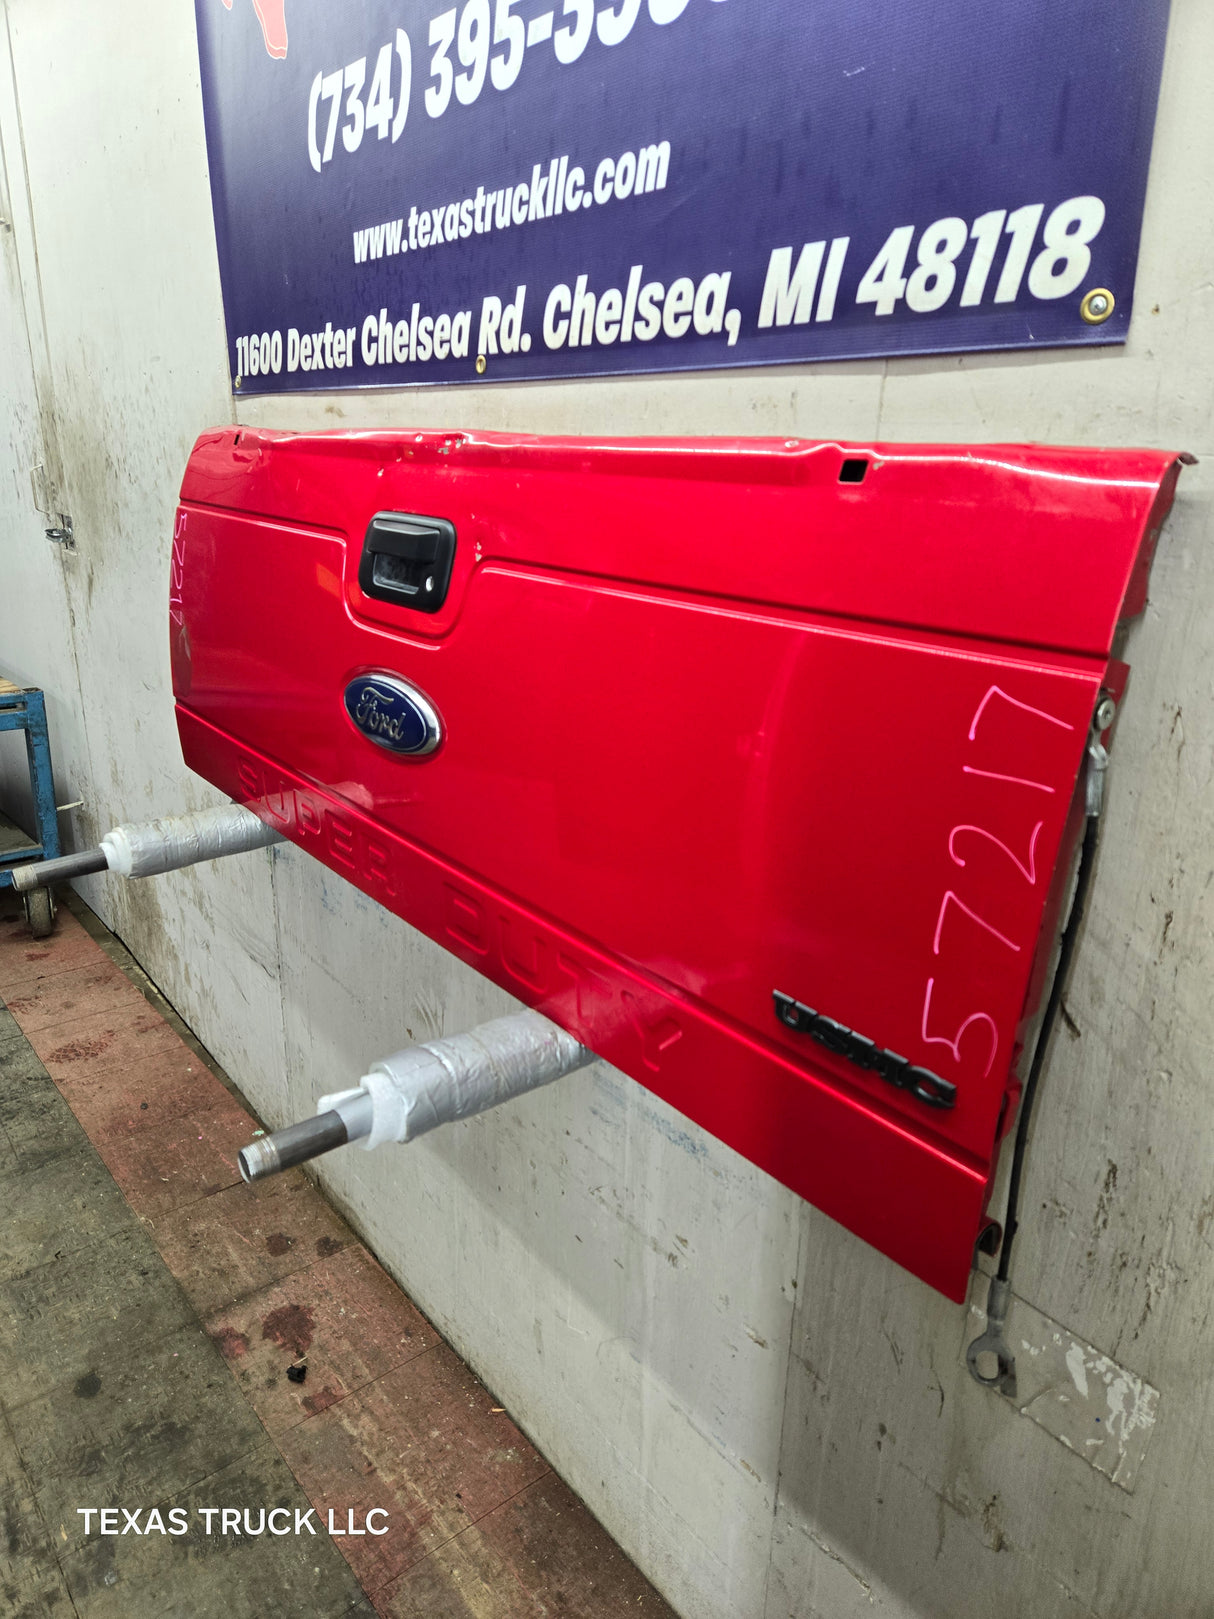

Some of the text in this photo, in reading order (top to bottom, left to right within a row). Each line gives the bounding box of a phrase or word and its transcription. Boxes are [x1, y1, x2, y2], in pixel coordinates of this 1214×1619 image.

[308, 27, 412, 173] (734)
[353, 140, 671, 264] www.texastruckllc.com
[235, 195, 1106, 377] 11600 Dexter Chelsea Rd. Chelsea, MI 48118
[356, 686, 406, 741] Ford
[237, 754, 683, 1072] SUPER DUTY
[922, 684, 1074, 1078] 57217
